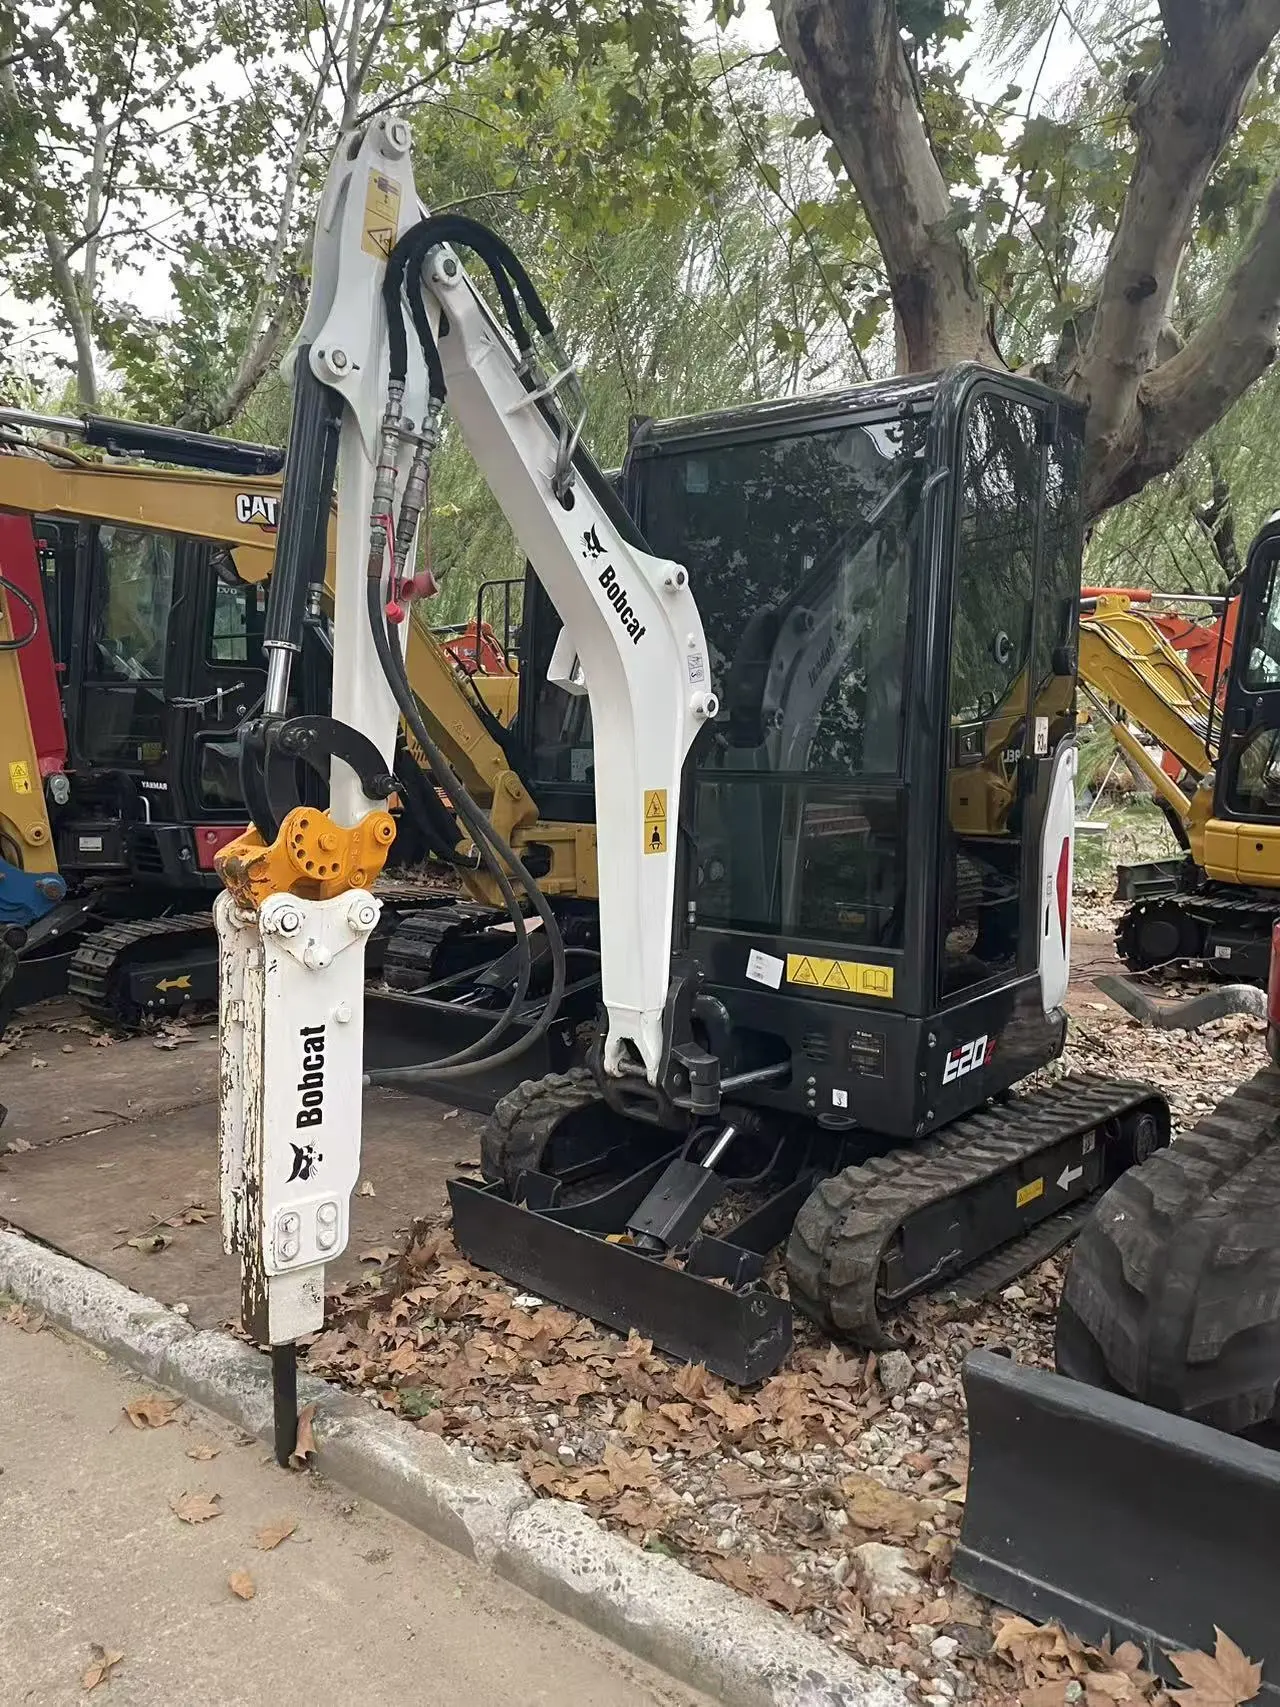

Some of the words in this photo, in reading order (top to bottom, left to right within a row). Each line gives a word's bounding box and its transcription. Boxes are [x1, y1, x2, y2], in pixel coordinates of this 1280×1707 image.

[236, 494, 277, 525] CAT
[598, 564, 646, 645] Bobcat
[296, 1024, 326, 1129] Bobcat
